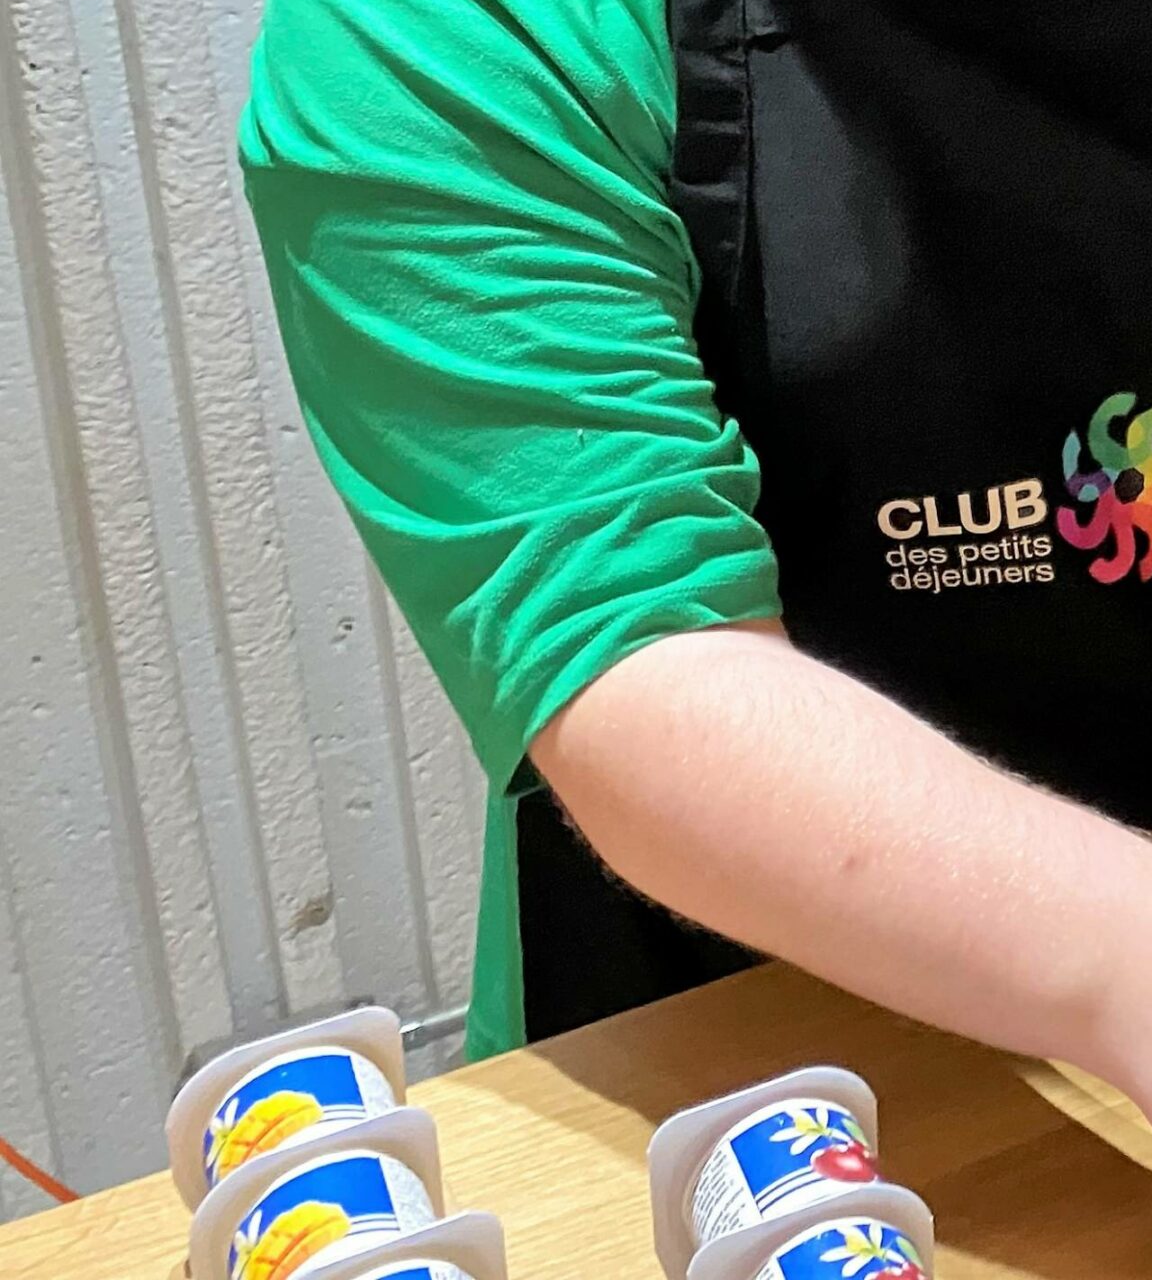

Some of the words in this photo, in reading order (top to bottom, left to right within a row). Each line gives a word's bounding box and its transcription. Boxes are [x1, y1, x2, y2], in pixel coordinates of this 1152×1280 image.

[877, 479, 1048, 539] CLUB
[885, 543, 948, 568] des
[958, 534, 1053, 567] petits
[889, 562, 1055, 594] déjeuners
